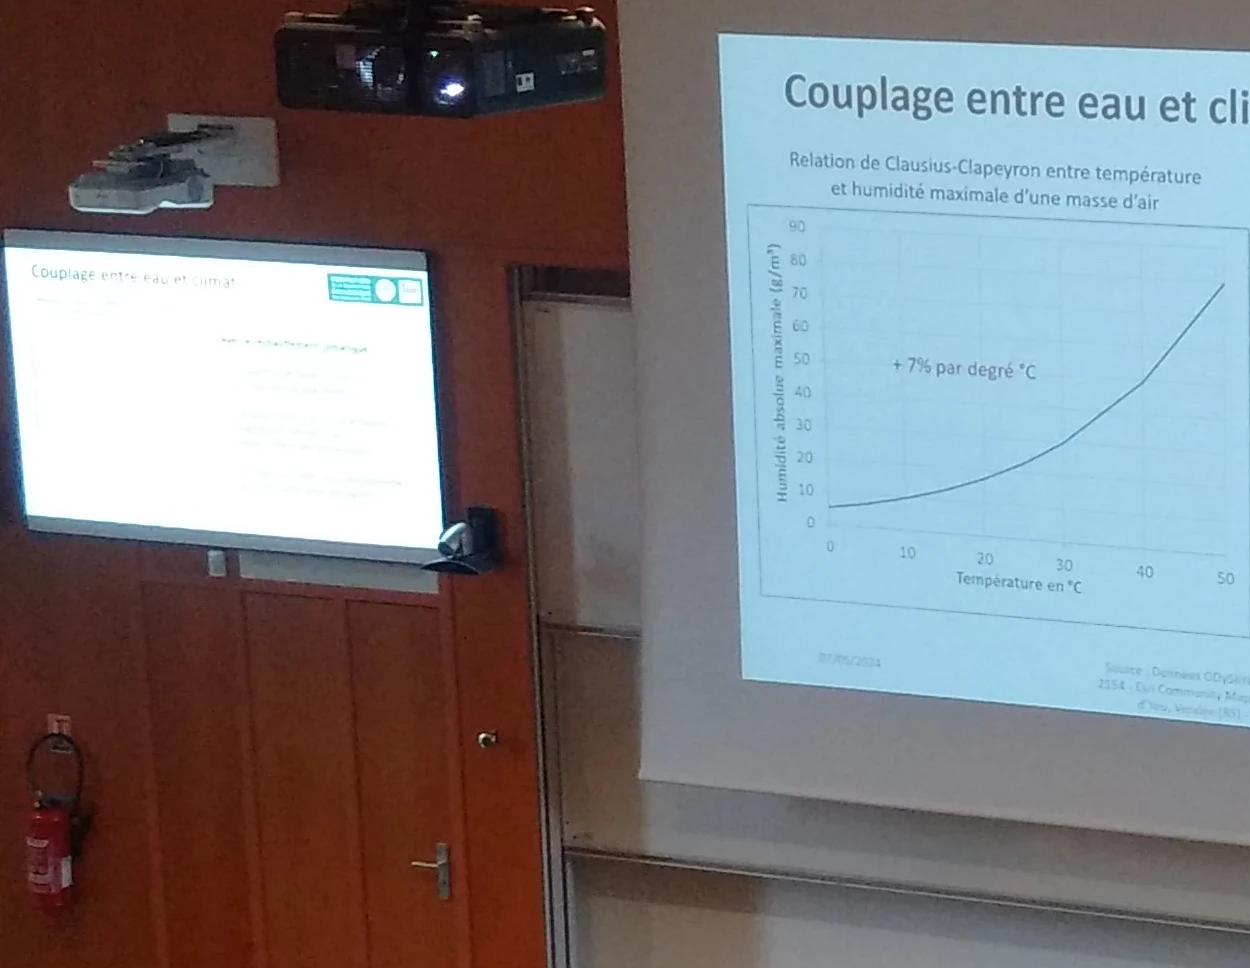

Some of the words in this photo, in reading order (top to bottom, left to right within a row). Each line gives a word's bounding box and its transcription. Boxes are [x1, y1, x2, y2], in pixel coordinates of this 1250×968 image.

[784, 73, 954, 121] Couplage
[966, 85, 1066, 119] entre
[1077, 92, 1146, 122] eau
[1158, 92, 1197, 123] et
[789, 151, 856, 170] Relation
[861, 154, 881, 171] de
[885, 155, 1041, 181] Clausius-Clapeyron
[1046, 163, 1090, 180] entre
[1095, 163, 1202, 187] température
[831, 182, 847, 196] et
[851, 180, 925, 200] humidité
[930, 184, 1009, 204] maximale
[1014, 186, 1060, 207] d'une
[1065, 193, 1118, 209] masse
[1123, 192, 1159, 211] d'air
[789, 219, 806, 233] 90
[790, 253, 807, 267] 80
[32, 264, 95, 283] Couplage
[792, 287, 808, 300] 70
[770, 299, 782, 369] maximale
[792, 320, 809, 333] 60
[794, 352, 810, 366] 50
[893, 360, 902, 370] +
[907, 357, 932, 375] 7%
[936, 361, 961, 379] par
[967, 360, 1013, 383] degré
[1019, 362, 1037, 380] °C
[795, 386, 812, 399] 40
[773, 376, 784, 430] absolue
[796, 418, 812, 432] 30
[797, 451, 813, 464] 20
[777, 436, 787, 502] Humidité
[799, 484, 814, 497] 10
[806, 515, 815, 528] 0
[827, 539, 835, 552] 0
[901, 545, 916, 559] 10
[977, 552, 993, 565] 20
[1056, 558, 1073, 573] 30
[1136, 565, 1154, 578] 40
[1217, 572, 1235, 585] 50
[956, 571, 1042, 592] Température
[1048, 580, 1064, 591] en
[1068, 579, 1082, 594] °C
